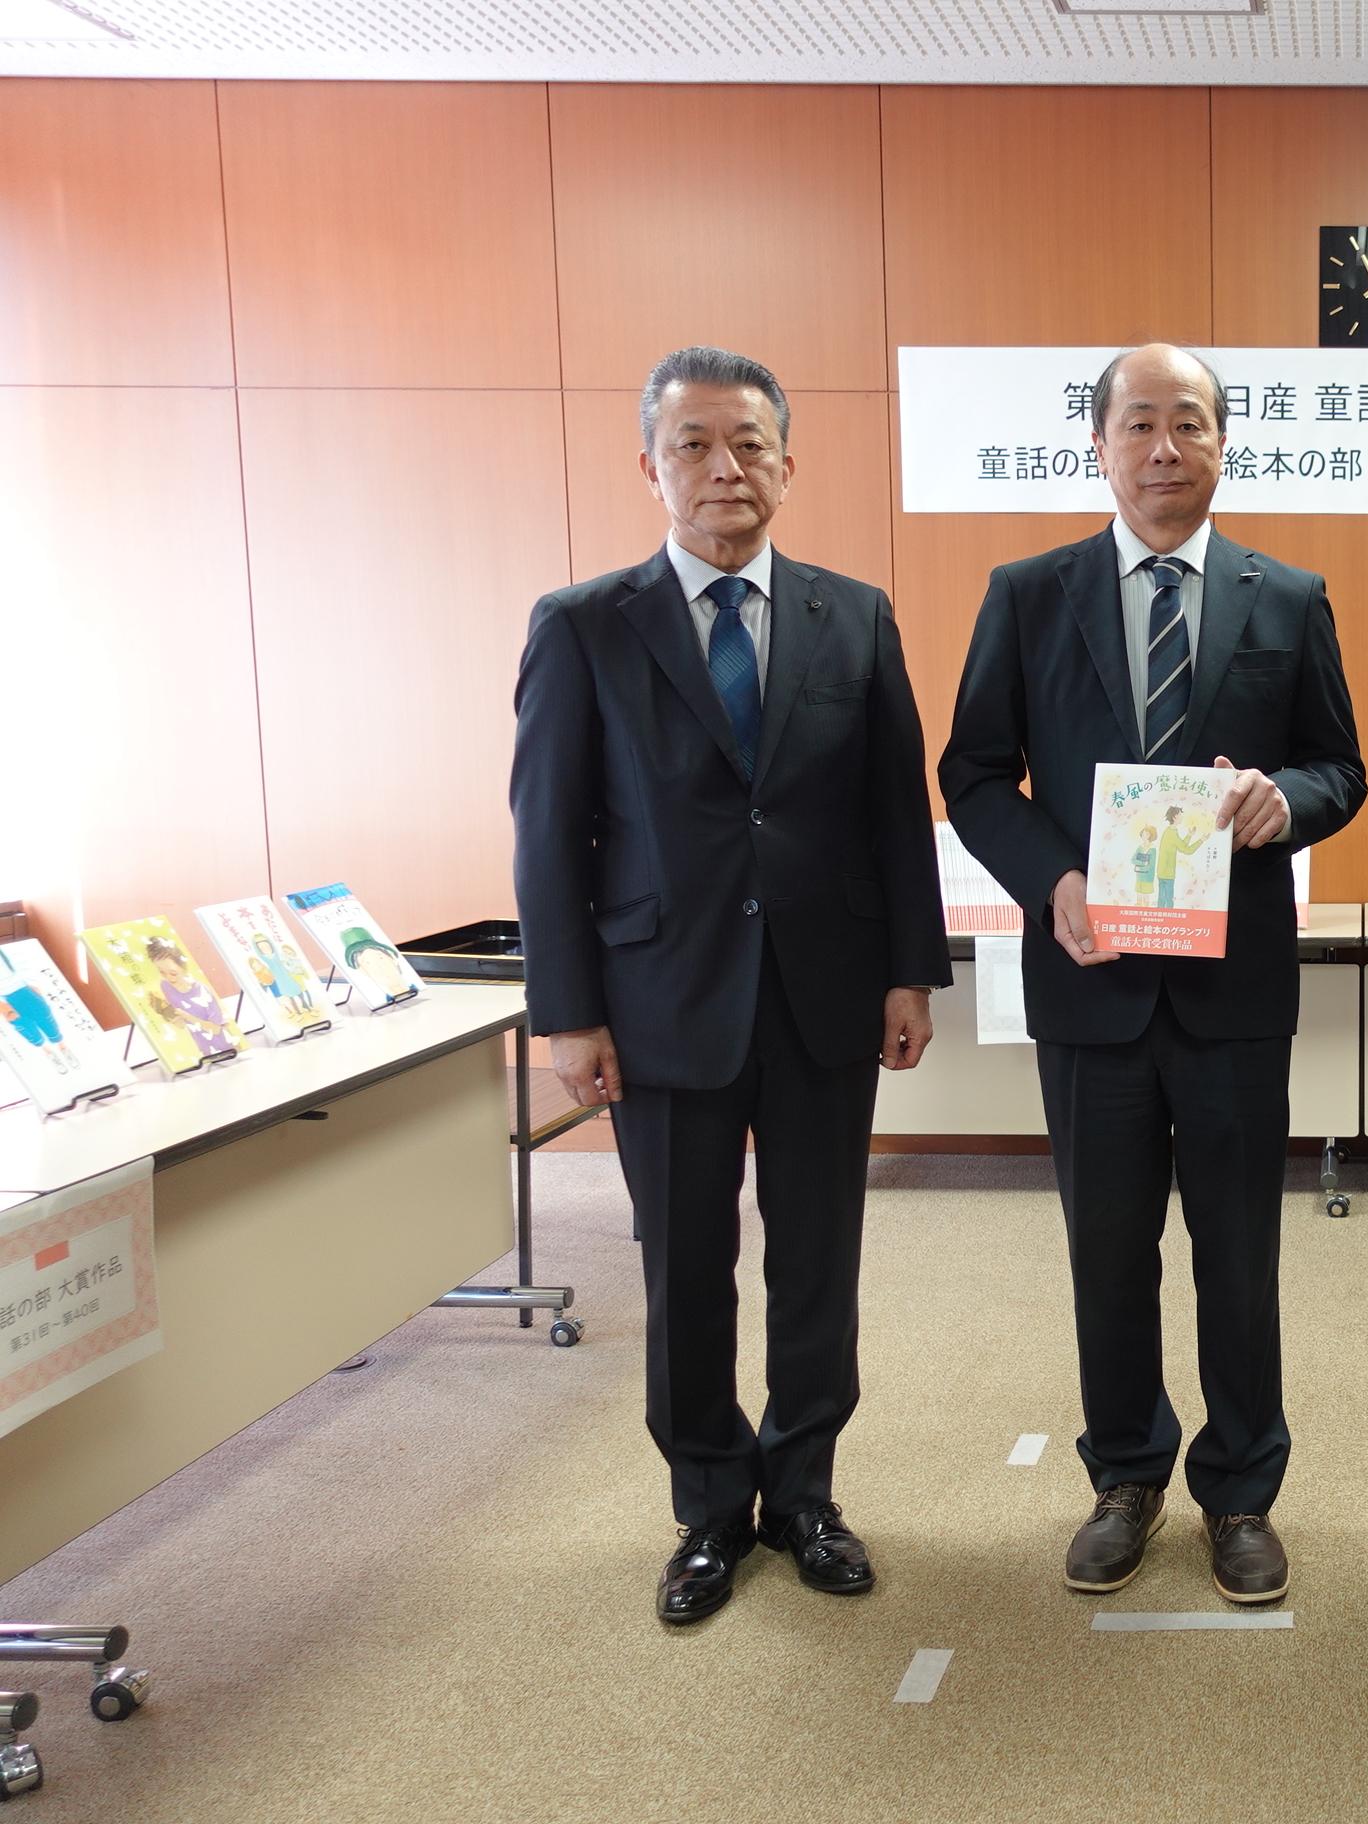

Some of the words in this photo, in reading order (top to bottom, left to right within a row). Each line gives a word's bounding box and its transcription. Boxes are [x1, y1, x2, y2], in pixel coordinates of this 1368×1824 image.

[1223, 382, 1298, 421] 日産
[1223, 445, 1362, 482] 絵本の部
[1111, 774, 1219, 809] 春風の魔法使い
[1110, 935, 1193, 950] 童話大賞受賞作品
[58, 1255, 123, 1303] 大賞作品
